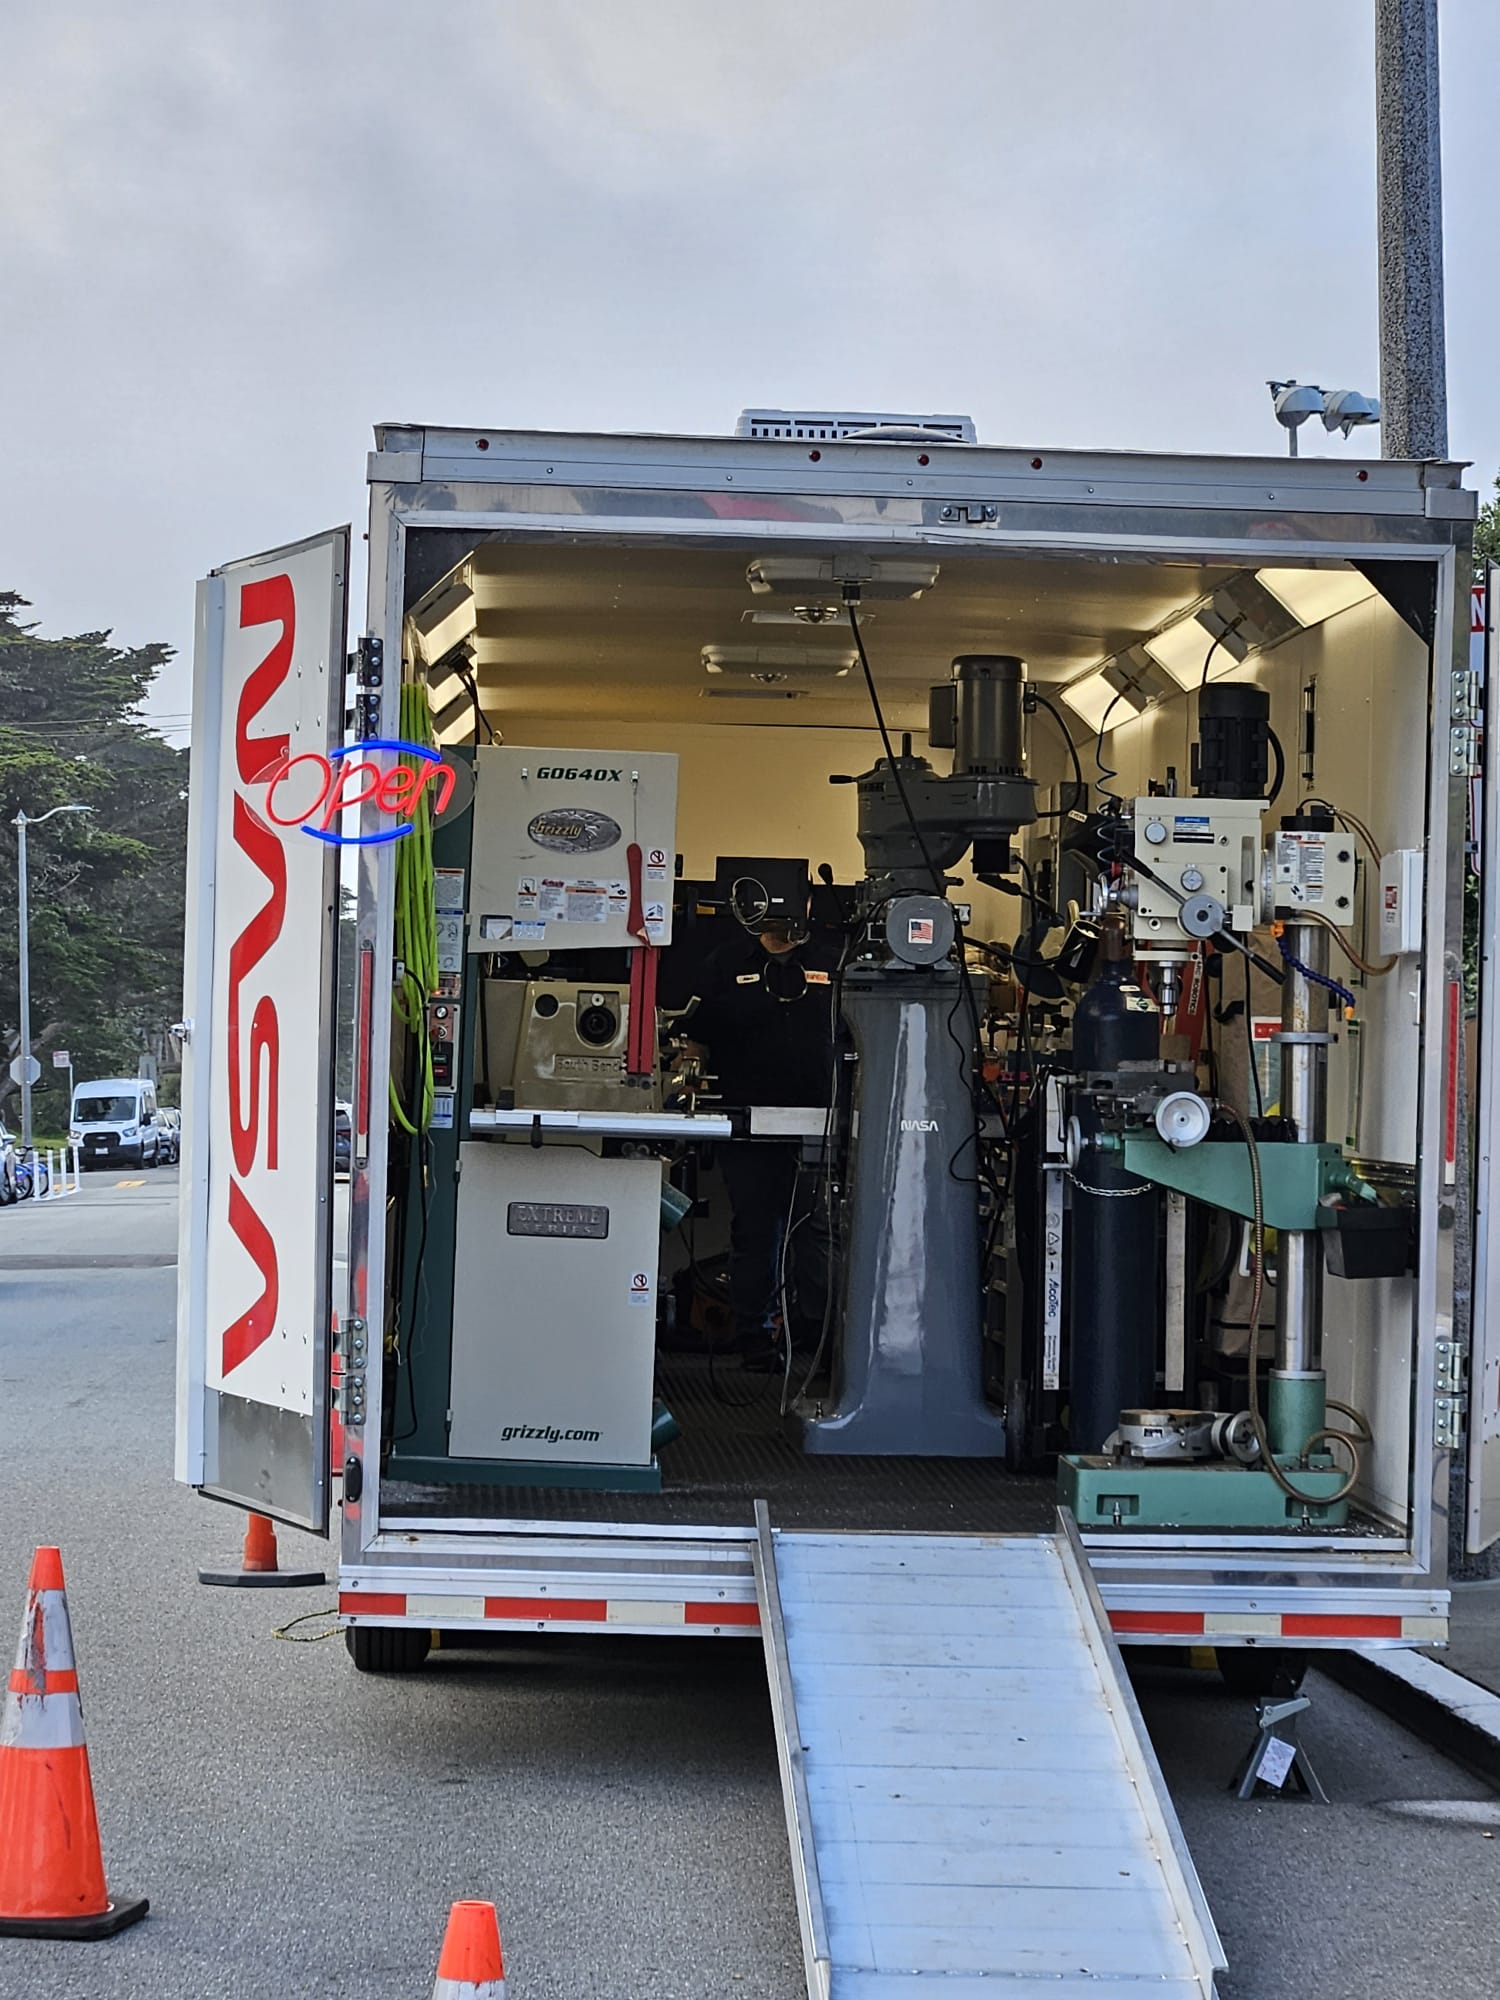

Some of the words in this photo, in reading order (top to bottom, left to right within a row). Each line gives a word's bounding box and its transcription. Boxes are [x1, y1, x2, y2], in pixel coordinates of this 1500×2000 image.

[537, 767, 623, 782] G0640X
[266, 753, 456, 831] Open
[535, 819, 582, 839] Grizzly
[222, 574, 296, 1379] NASA
[557, 1057, 588, 1072] South
[592, 1059, 621, 1073] Bend
[900, 1119, 939, 1132] NASA
[518, 1205, 600, 1224] EXTREME
[522, 1223, 592, 1234] SERIES
[500, 1424, 601, 1443] grizzly.com
